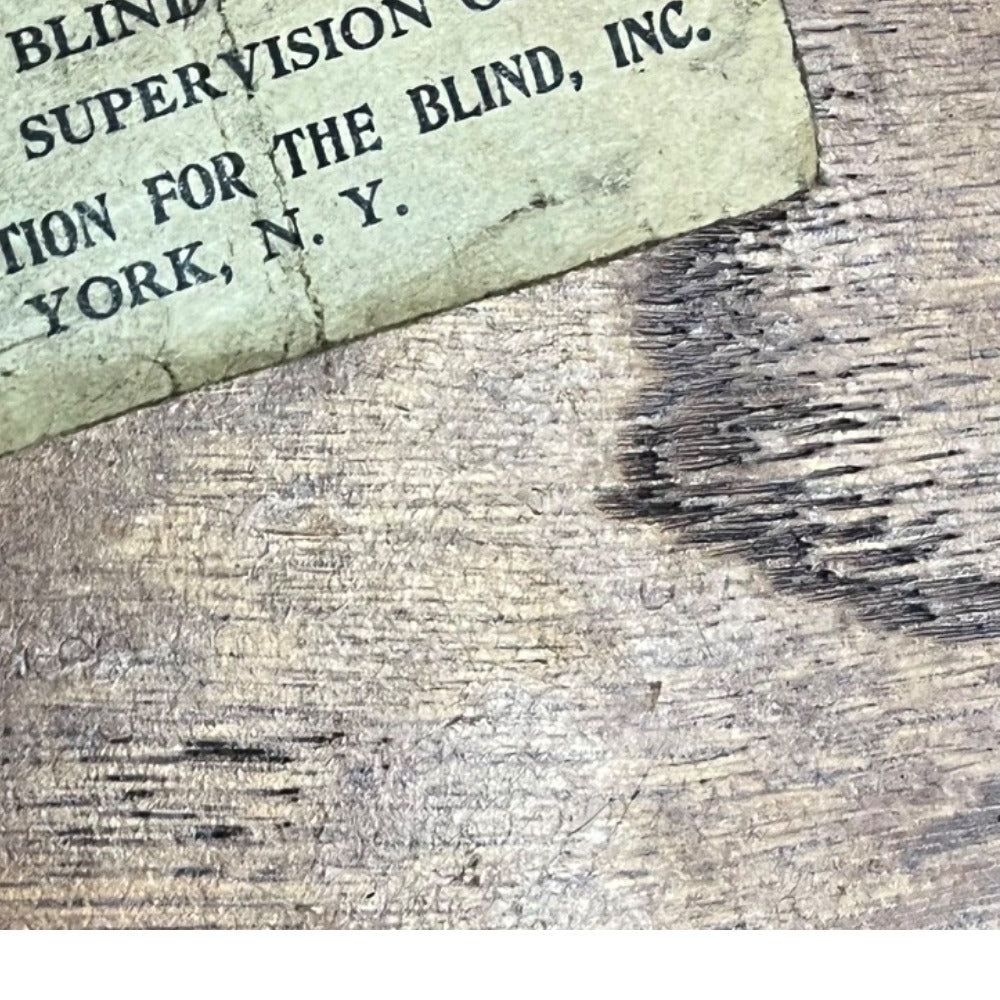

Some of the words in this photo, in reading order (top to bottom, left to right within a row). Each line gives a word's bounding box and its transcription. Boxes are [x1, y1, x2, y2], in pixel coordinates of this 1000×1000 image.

[143, 150, 257, 226] FOR
[272, 103, 385, 179] THE
[406, 45, 584, 135] BLIND,
[23, 240, 233, 339] YORK,
[251, 205, 326, 261] N.
[340, 179, 409, 230] Y.
